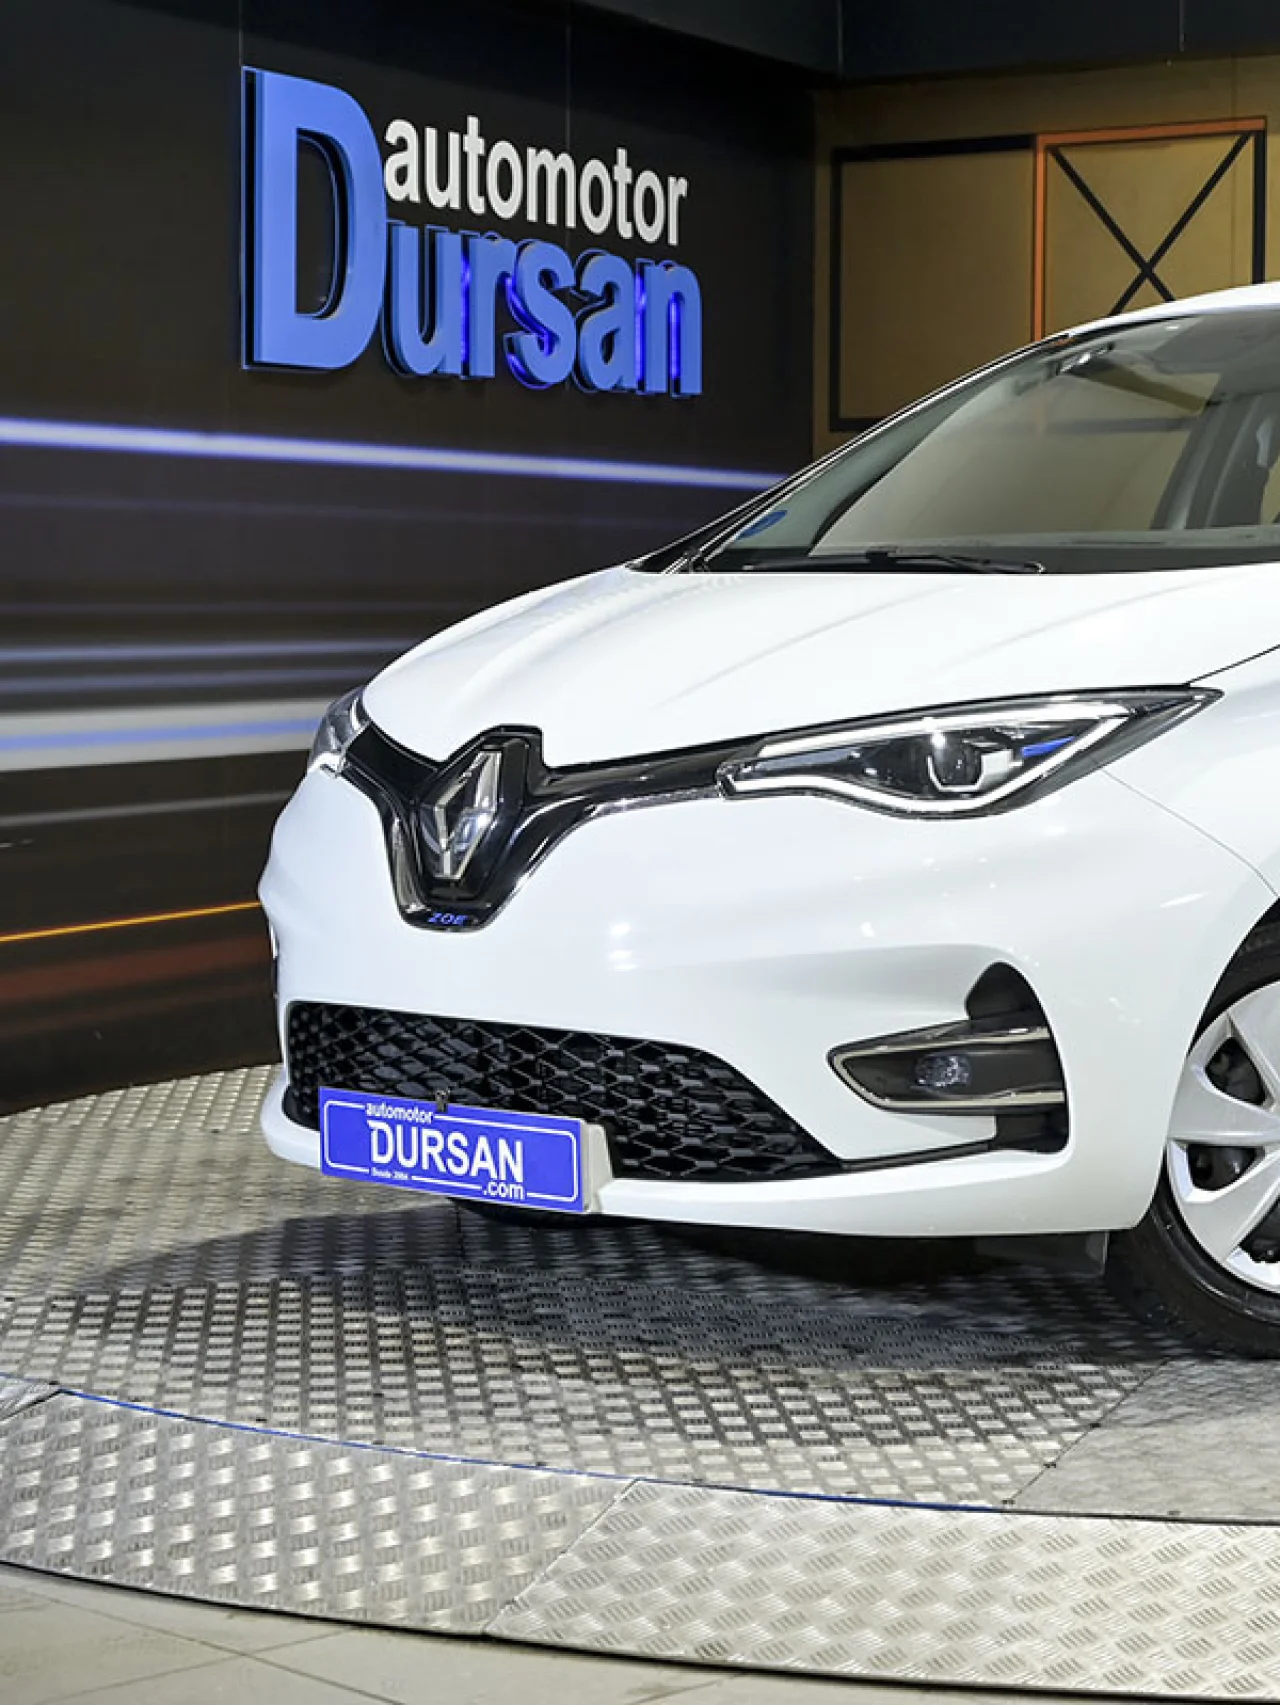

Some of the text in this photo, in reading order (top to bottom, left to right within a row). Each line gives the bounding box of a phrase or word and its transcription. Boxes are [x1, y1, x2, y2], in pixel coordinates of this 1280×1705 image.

[384, 115, 688, 246] automotor
[241, 65, 702, 397] Dursan
[428, 912, 468, 925] ZOE
[366, 1102, 433, 1123] automotor
[367, 1120, 523, 1182] DURSAN
[483, 1180, 524, 1200] .com
